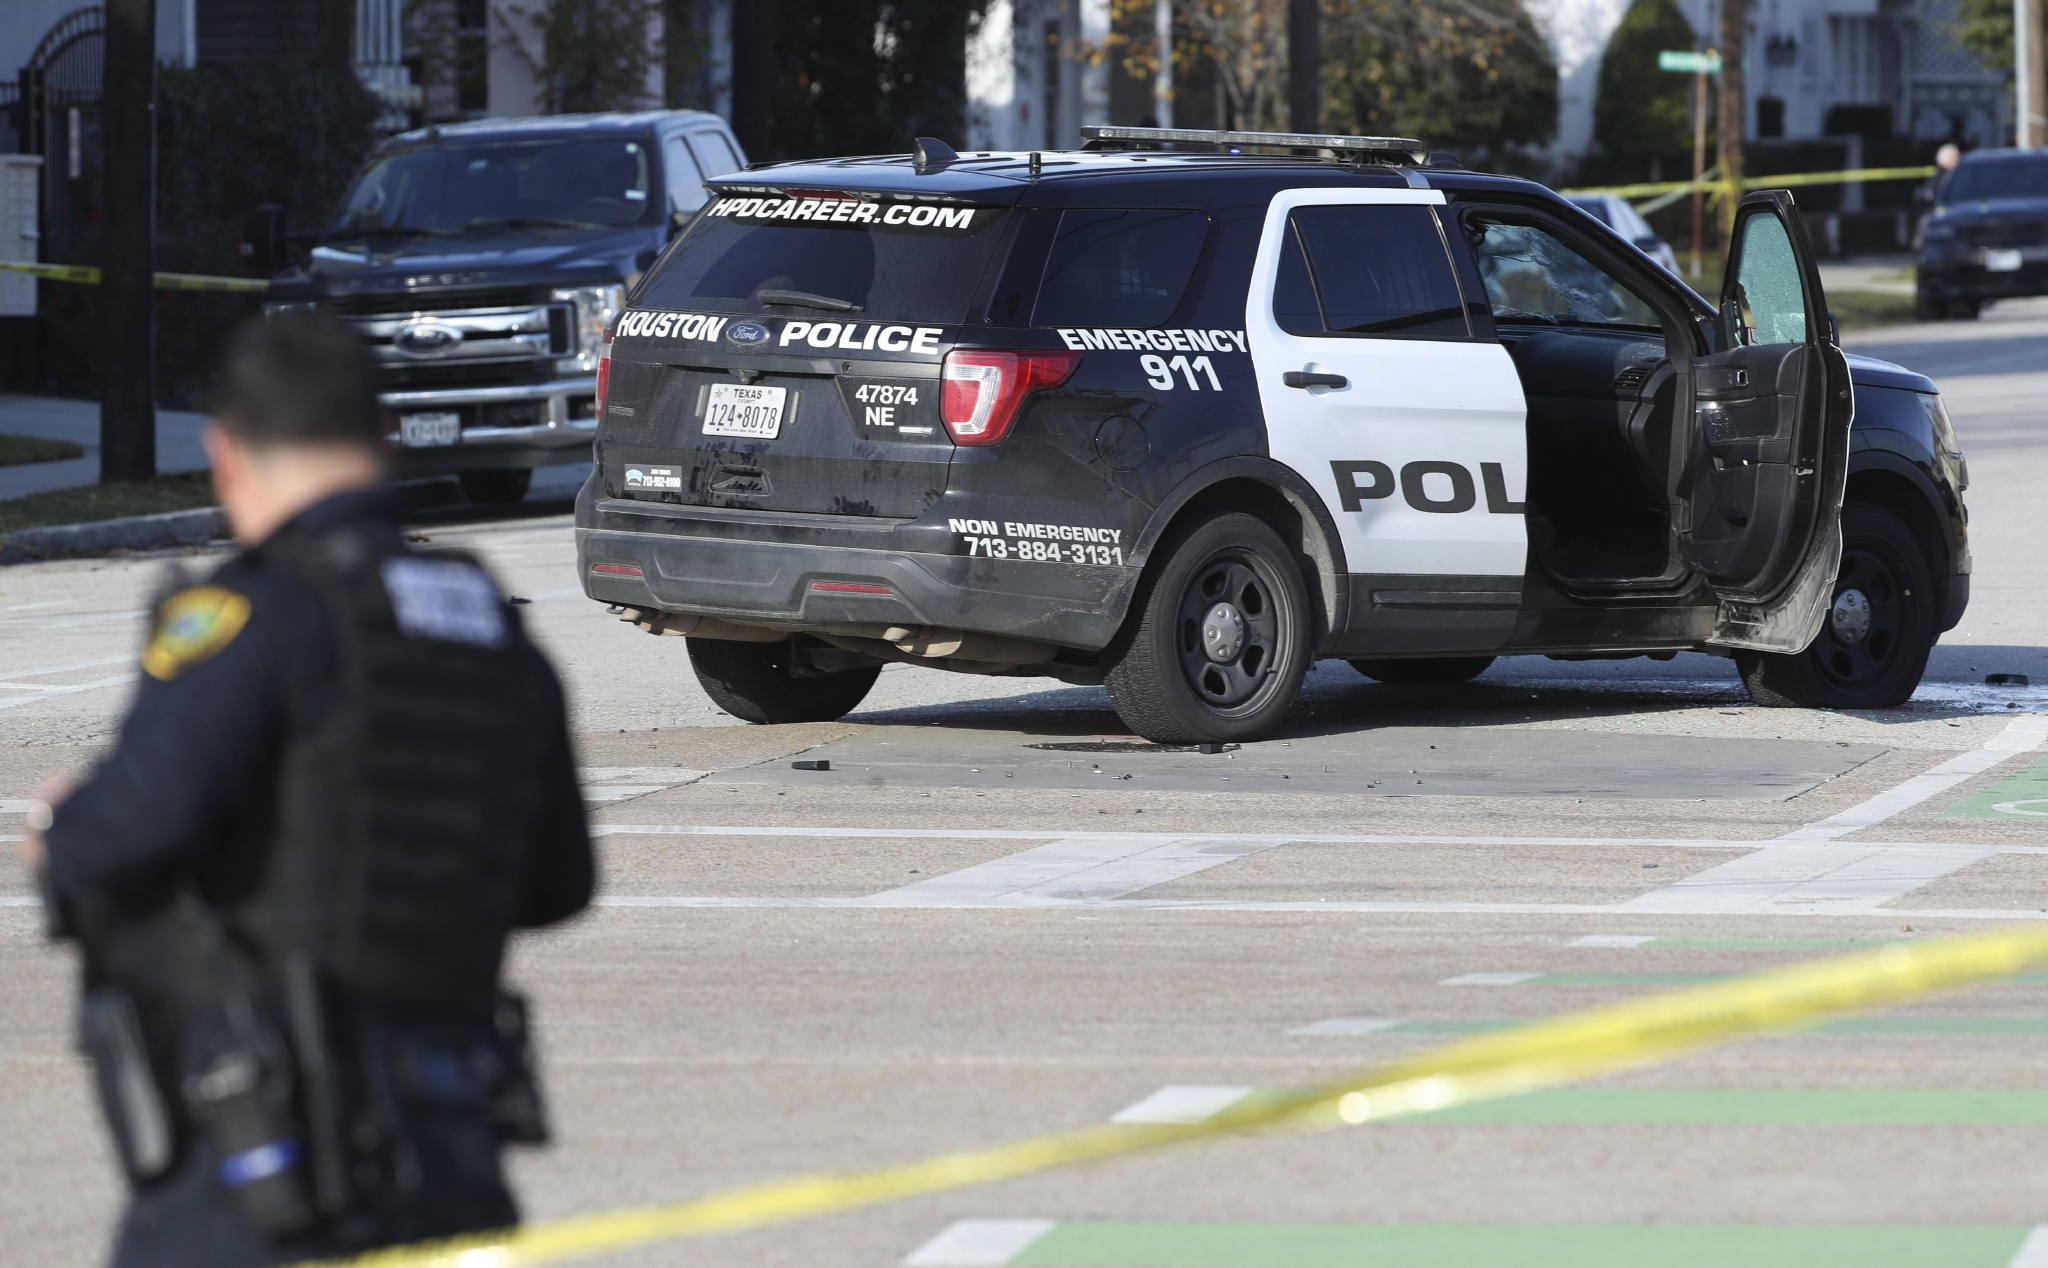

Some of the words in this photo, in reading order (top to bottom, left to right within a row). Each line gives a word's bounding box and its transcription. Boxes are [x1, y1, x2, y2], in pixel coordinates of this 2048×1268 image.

[707, 198, 975, 229] HPDCAREER.COM
[616, 311, 728, 342] HOUSTON
[779, 322, 943, 355] POLICE
[733, 325, 759, 340] Ford
[1057, 329, 1247, 353] EMERGENCY
[1140, 354, 1223, 391] 911
[734, 388, 762, 399] TEXAS
[855, 384, 918, 406] 47874
[865, 406, 895, 426] NE
[948, 519, 998, 535] NON
[1004, 522, 1121, 544] EMERGENCY
[964, 537, 1122, 566] 713-884-3131
